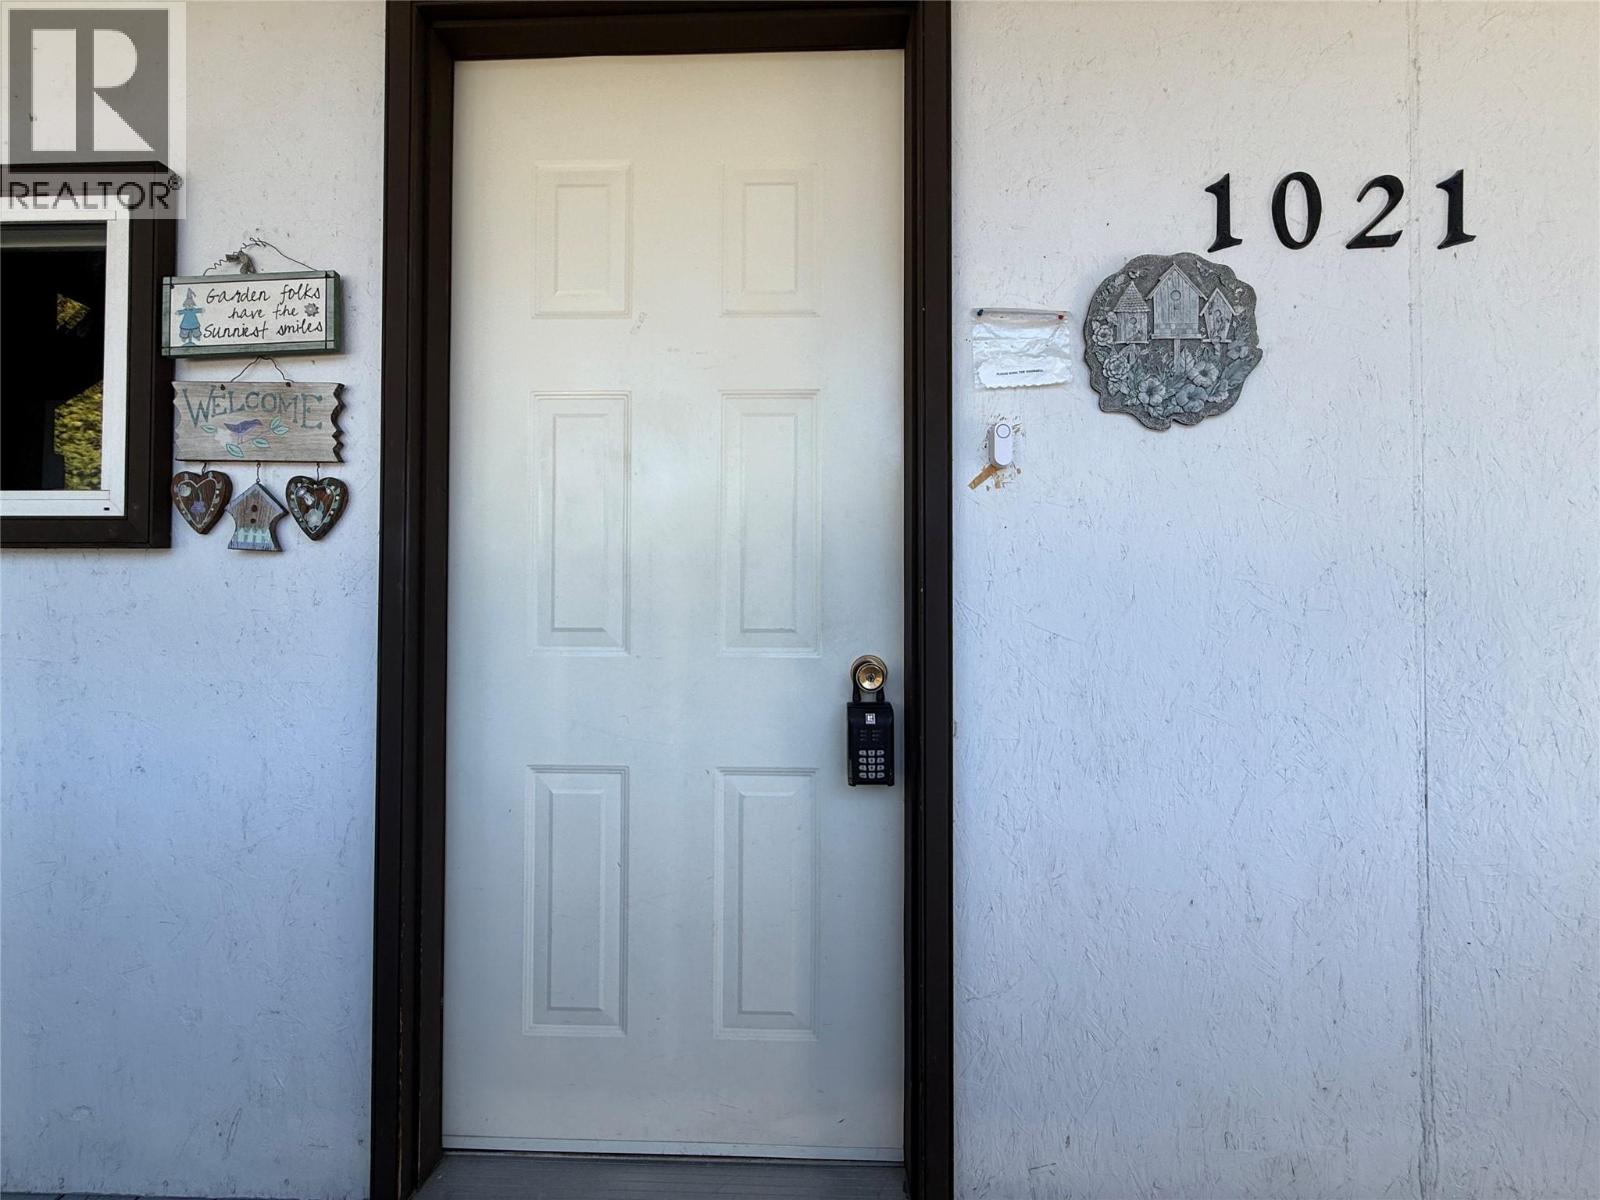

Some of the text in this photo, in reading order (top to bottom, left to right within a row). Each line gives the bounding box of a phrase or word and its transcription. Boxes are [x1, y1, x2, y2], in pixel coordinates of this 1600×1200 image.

[1204, 168, 1477, 253] 1021
[206, 283, 321, 305] Garden folks
[227, 303, 299, 320] have the
[276, 319, 324, 336] smiles
[182, 384, 323, 430] WELCOME
